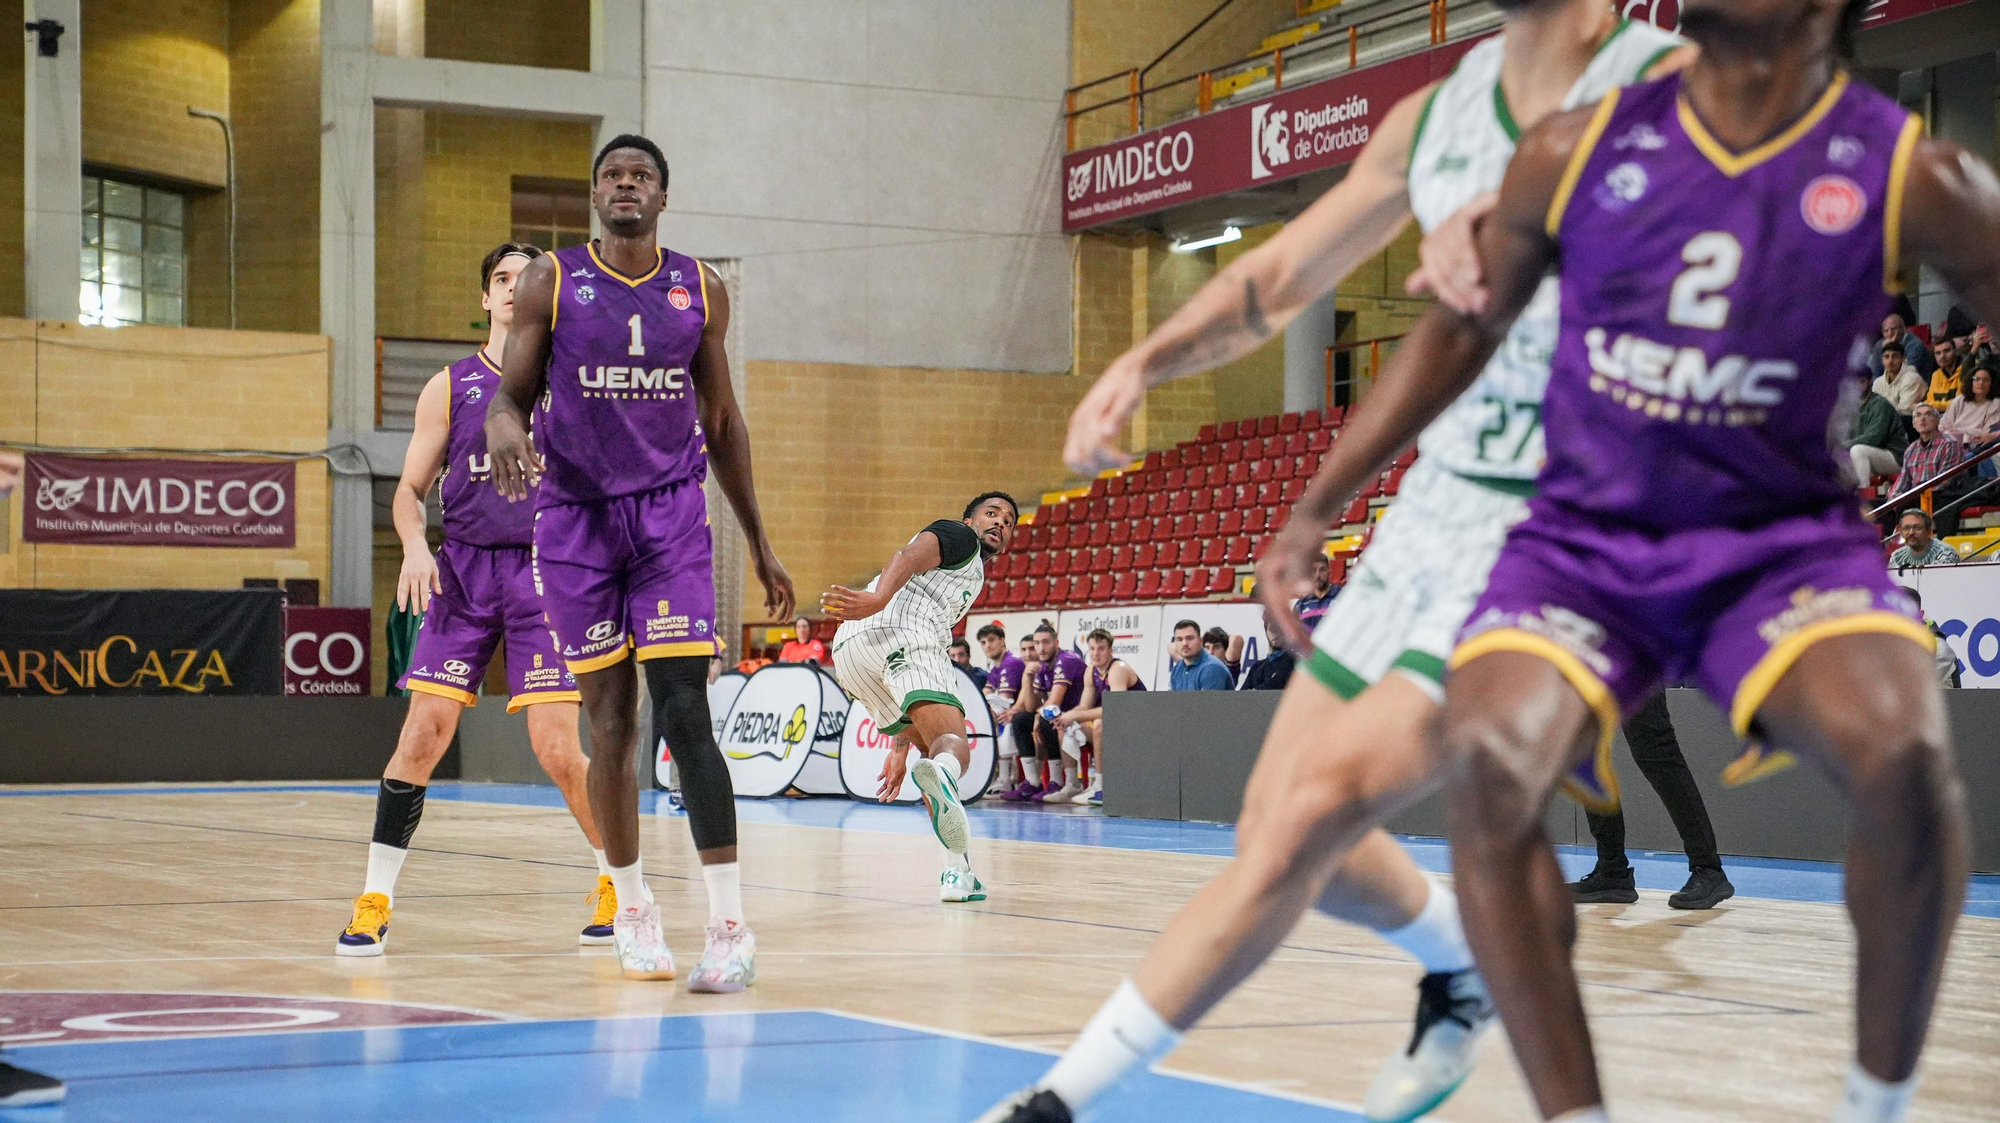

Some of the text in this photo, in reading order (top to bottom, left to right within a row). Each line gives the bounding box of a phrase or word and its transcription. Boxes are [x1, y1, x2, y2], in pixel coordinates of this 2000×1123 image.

[1294, 94, 1368, 135] Diputación
[1095, 130, 1194, 194] IMDECO
[1294, 124, 1369, 160] de Córdoba
[1667, 229, 1742, 331] 2
[627, 313, 645, 356] 1
[578, 365, 686, 390] UEMC
[1584, 326, 1799, 406] UEMC
[96, 476, 286, 516] IMDECO
[36, 518, 88, 532] Instituto
[92, 520, 152, 536] Municipal
[155, 522, 171, 534] de
[174, 522, 230, 537] Deportes
[1078, 619, 1092, 631] San
[1094, 617, 1118, 630] Carlos
[1125, 615, 1132, 629] &
[285, 632, 364, 676] CO
[1113, 644, 1138, 655] aciones
[300, 680, 360, 694] Córdoba
